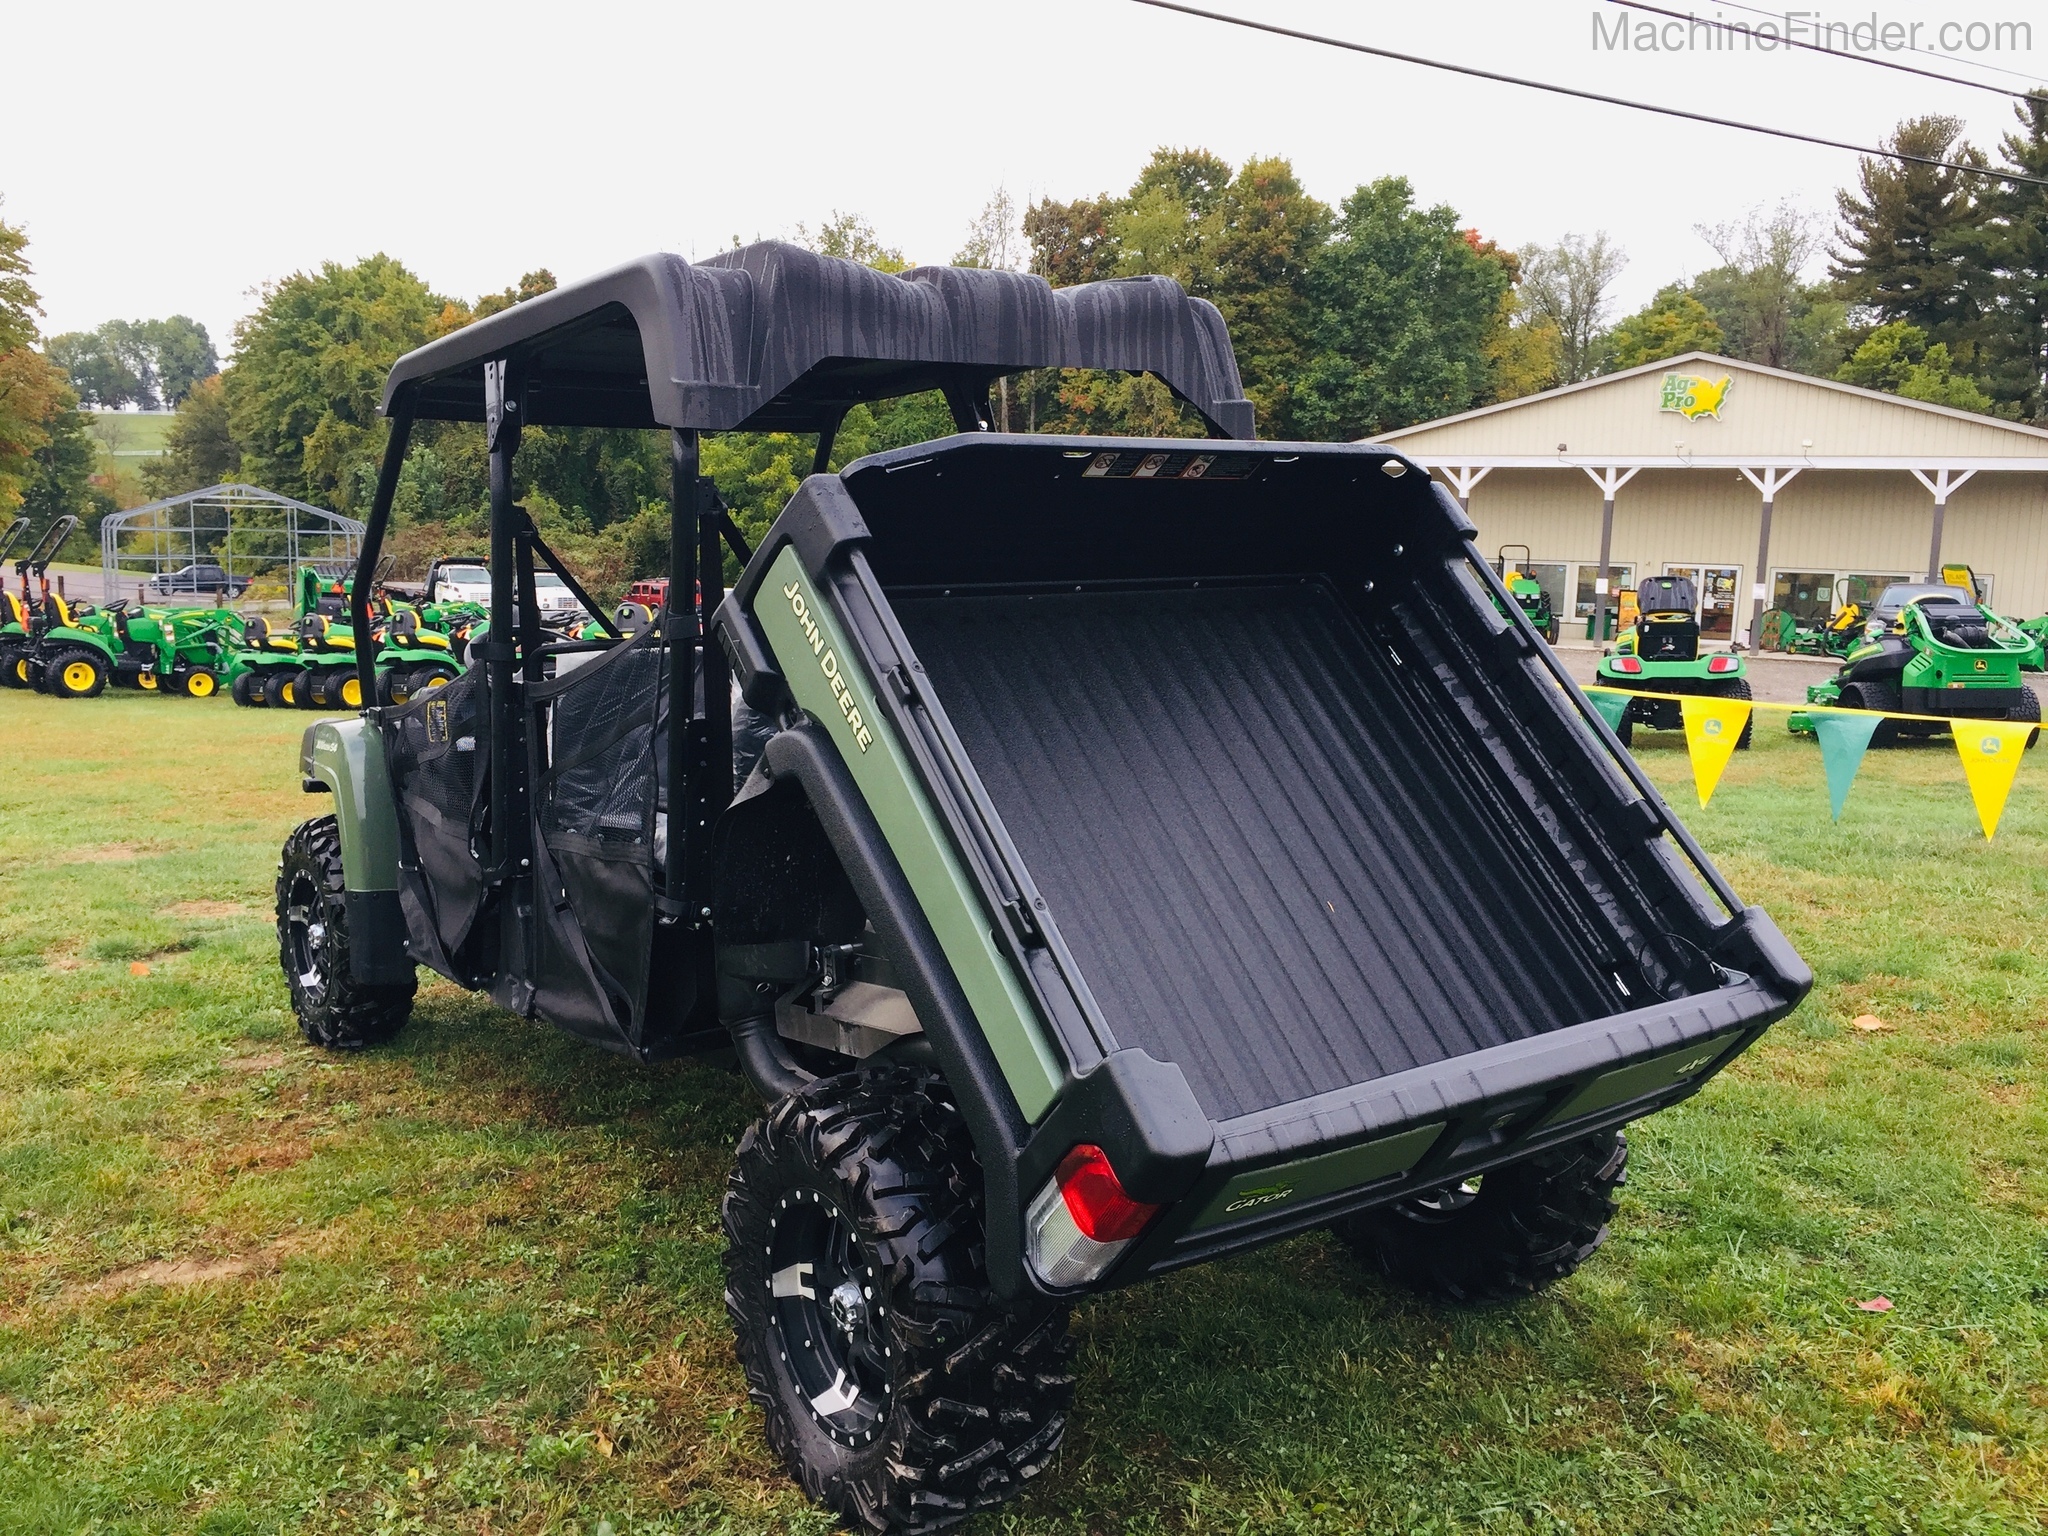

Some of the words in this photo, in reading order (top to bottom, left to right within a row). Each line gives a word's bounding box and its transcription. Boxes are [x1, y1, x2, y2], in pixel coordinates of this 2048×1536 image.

[1661, 392, 1696, 408] Pro
[783, 579, 825, 656] JOHN
[820, 648, 874, 754] DEERE
[1225, 1189, 1293, 1212] GATOR
